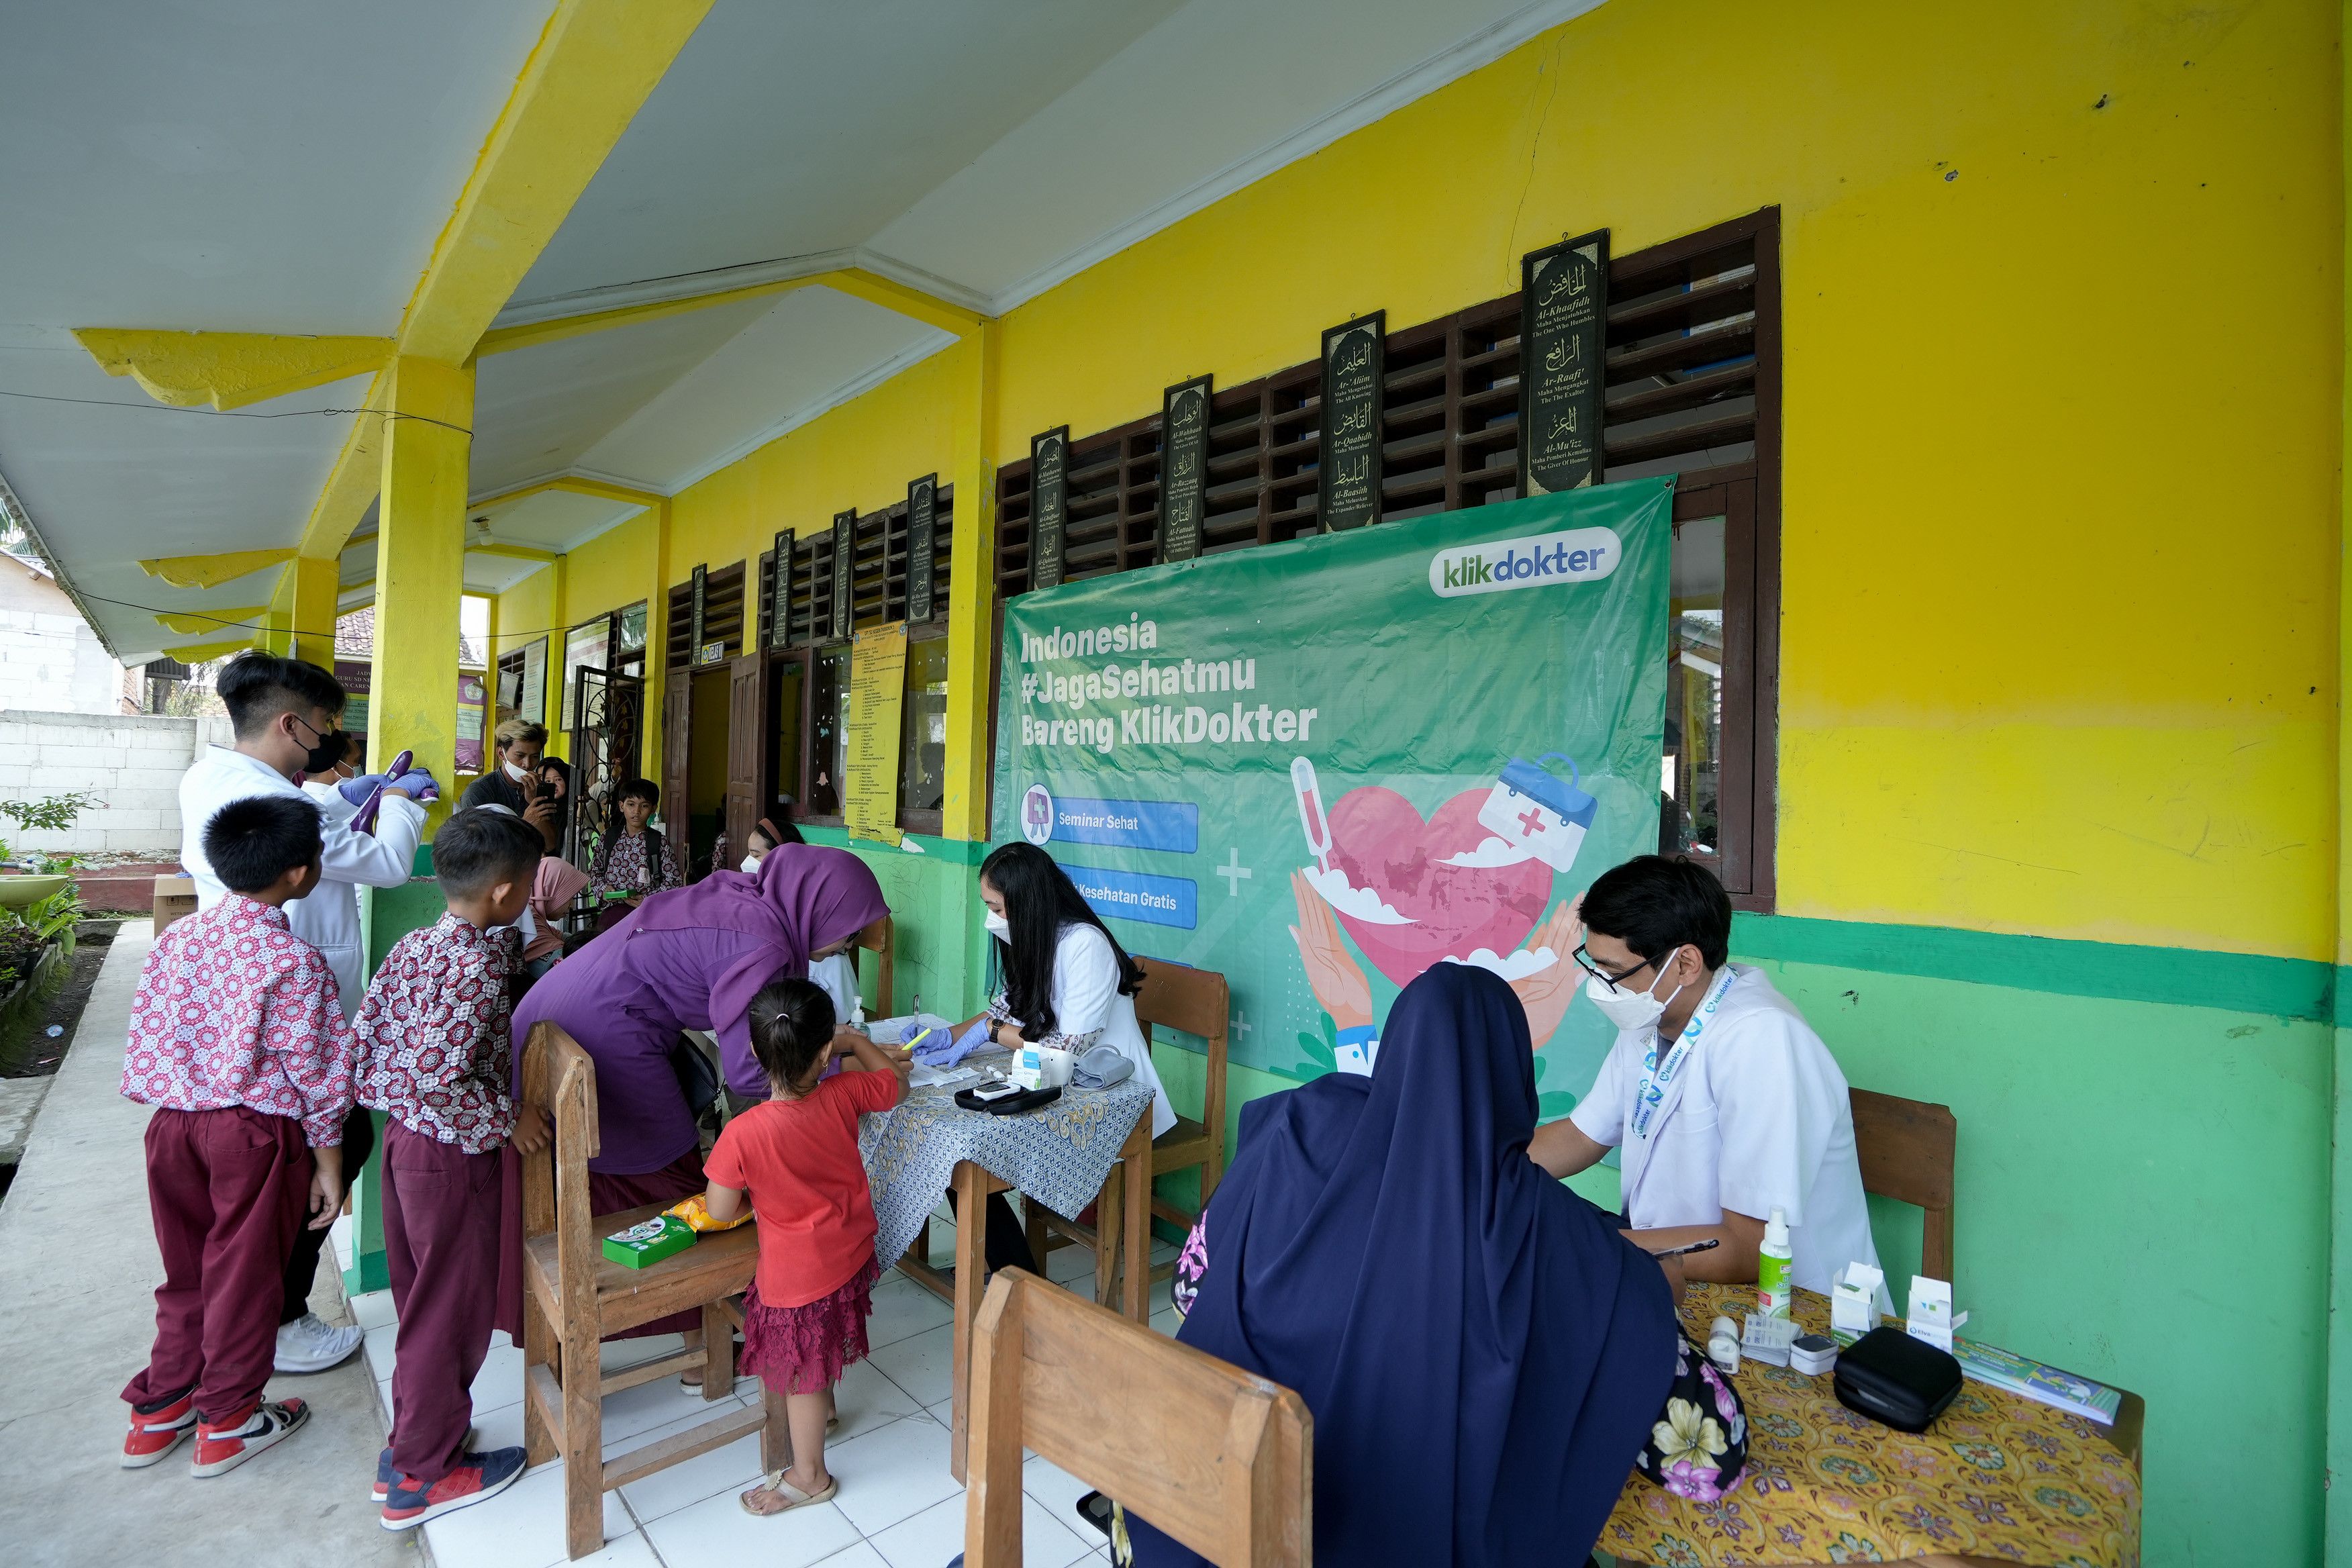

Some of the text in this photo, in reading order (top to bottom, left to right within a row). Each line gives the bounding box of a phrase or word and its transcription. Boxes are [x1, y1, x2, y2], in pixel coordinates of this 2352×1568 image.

[1536, 296, 1590, 322] Al-Khaafidh
[1536, 308, 1590, 329] Maha Menjatuhkan
[1557, 322, 1569, 330] Who
[1571, 315, 1596, 327] Humbles
[1352, 391, 1371, 400] Knowing
[1537, 379, 1589, 397] Maha Mengangkat
[1553, 393, 1563, 401] The
[1565, 389, 1585, 397] Exalter
[1547, 453, 1567, 461] Pemberi
[1547, 461, 1561, 469] Giver
[1569, 456, 1589, 464] Honour
[1442, 542, 1606, 589] klikdokter
[1021, 611, 1157, 663] Indonesia
[1022, 658, 1255, 709] #JagaSehatmu
[1022, 702, 1316, 752] Bareng KlikDokter
[1059, 812, 1138, 831] Seminar Sehat
[1079, 883, 1138, 905] Kesehatan
[1140, 891, 1176, 910] Gratis
[1714, 976, 1732, 1005] klikdokter
[1665, 1046, 1683, 1074] klikdokter
[1634, 1089, 1645, 1119] klikdokter
